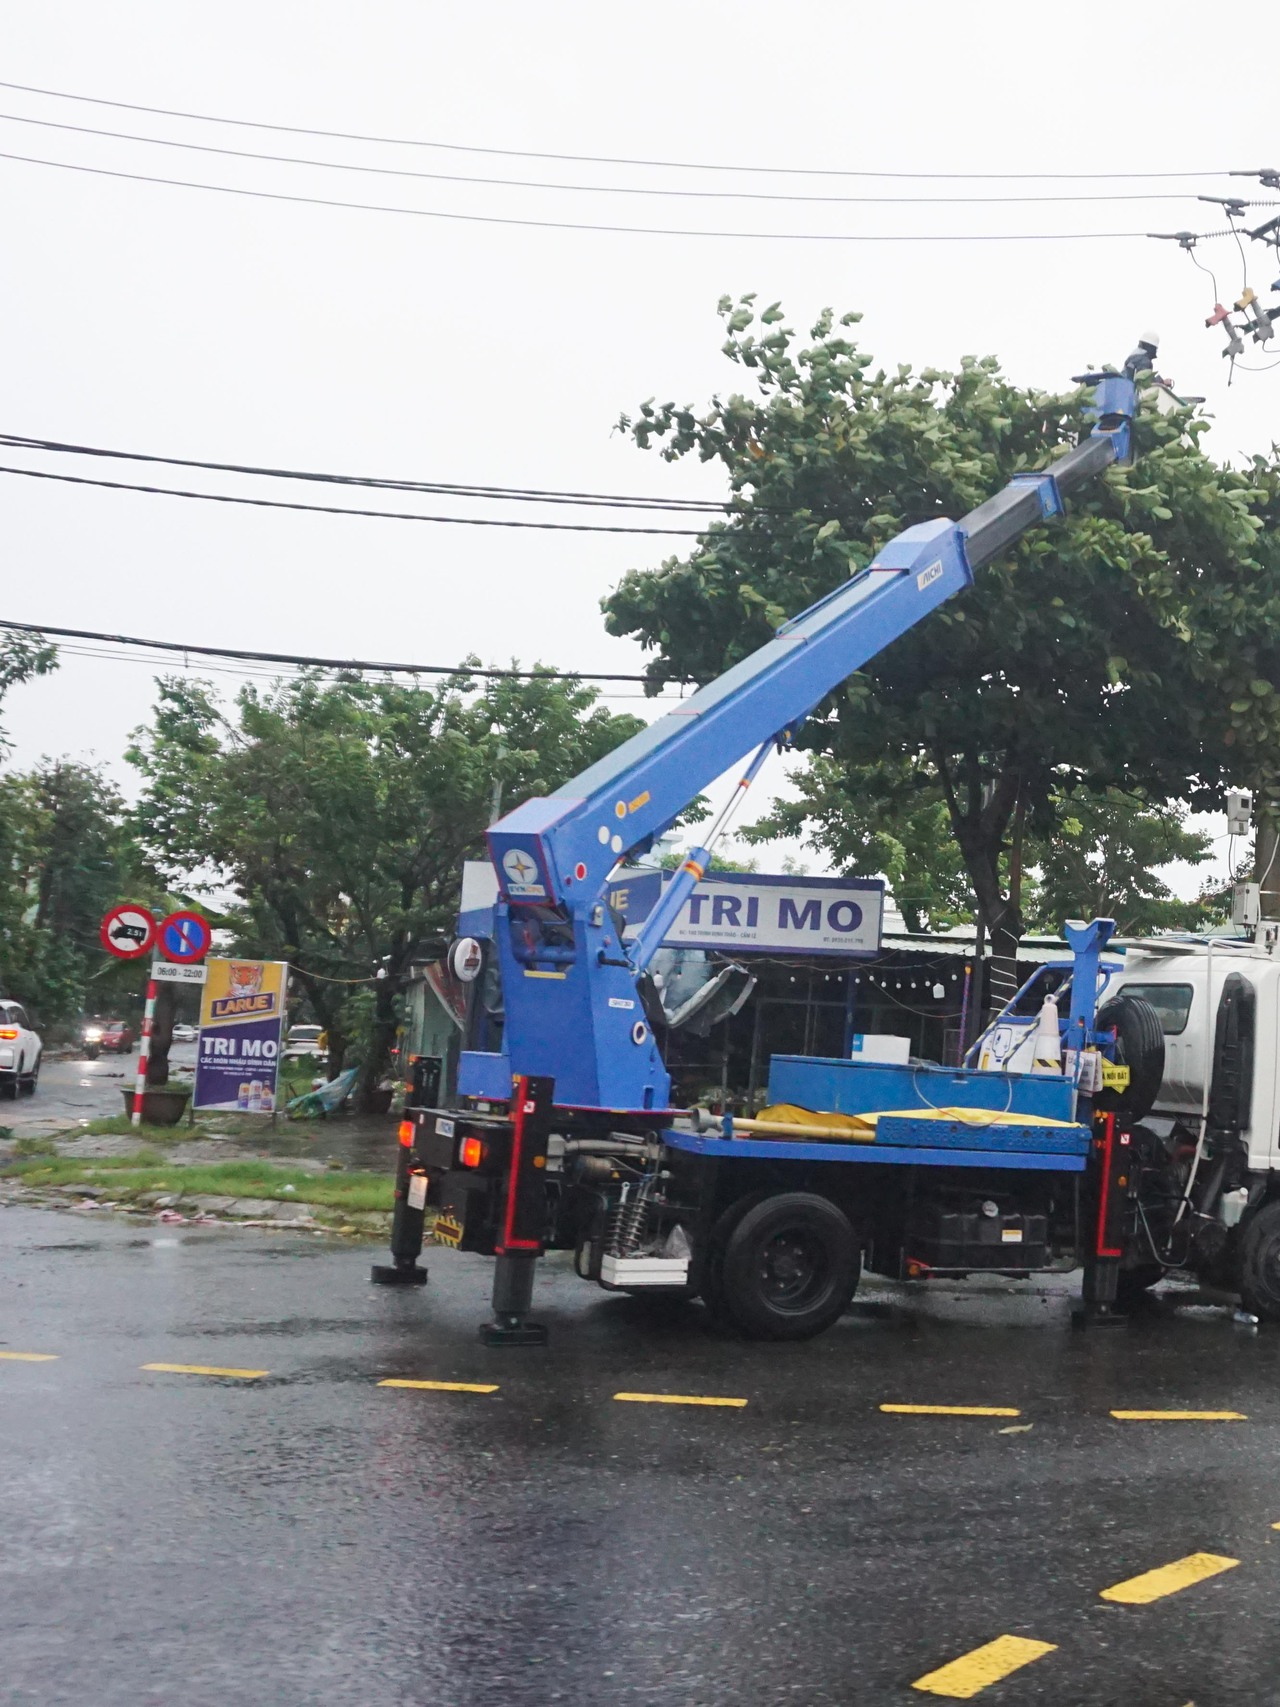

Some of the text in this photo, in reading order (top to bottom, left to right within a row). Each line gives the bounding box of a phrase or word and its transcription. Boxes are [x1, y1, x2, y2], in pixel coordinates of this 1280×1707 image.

[687, 894, 863, 933] TRI MO
[157, 967, 178, 977] 06:00
[183, 969, 203, 979] 22:00
[216, 995, 270, 1015] LARUE
[202, 1037, 278, 1058] TRI MO
